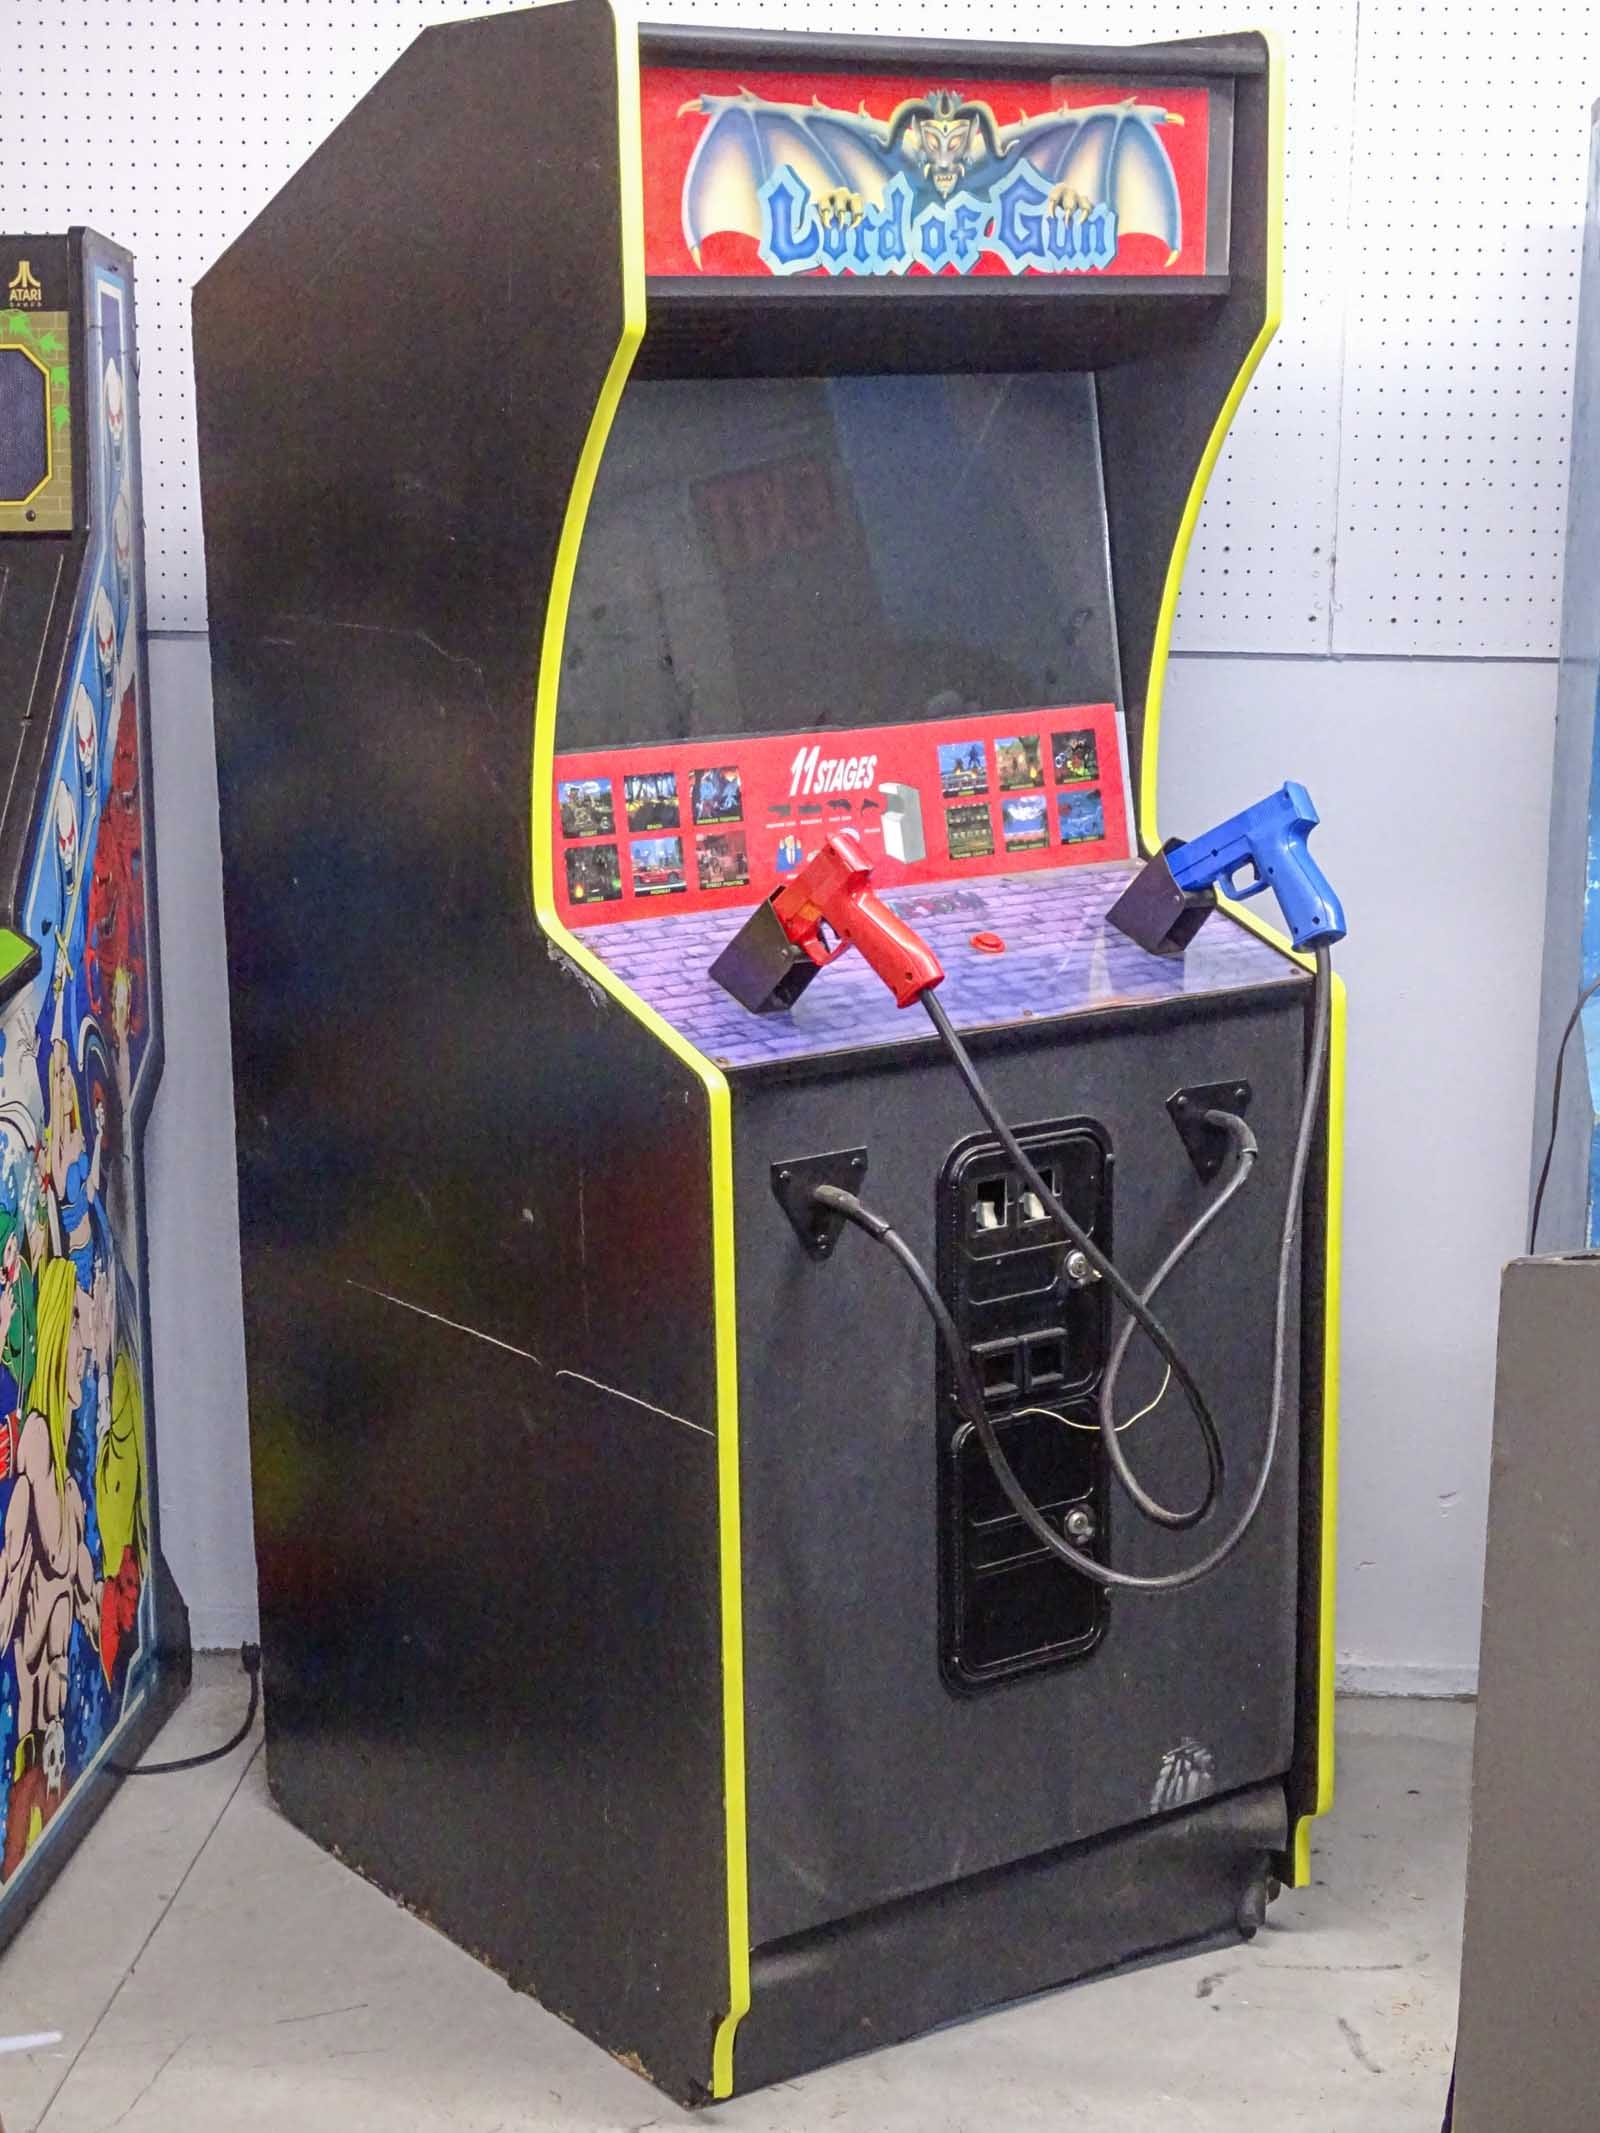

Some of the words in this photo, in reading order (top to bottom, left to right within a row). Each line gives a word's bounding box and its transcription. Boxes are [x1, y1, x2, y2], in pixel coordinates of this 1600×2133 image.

[762, 168, 911, 271] Lord
[916, 196, 983, 269] of
[995, 166, 1113, 268] Gun
[9, 288, 42, 301] ATARI
[789, 745, 821, 797] 11
[813, 754, 877, 794] STAGES
